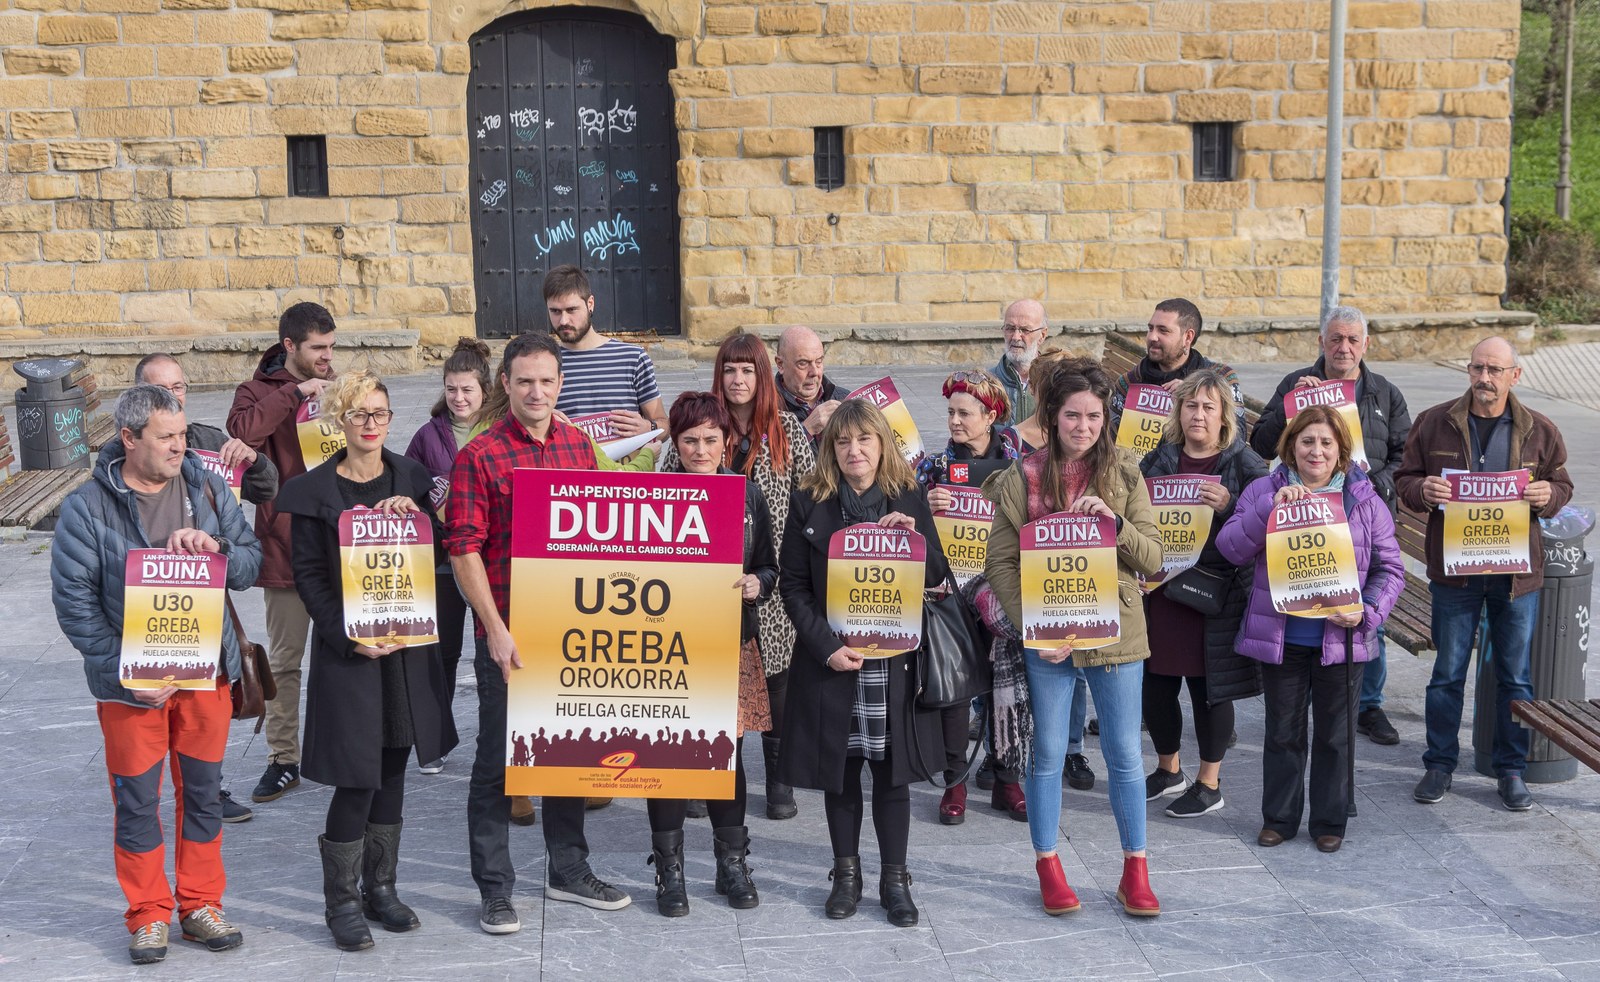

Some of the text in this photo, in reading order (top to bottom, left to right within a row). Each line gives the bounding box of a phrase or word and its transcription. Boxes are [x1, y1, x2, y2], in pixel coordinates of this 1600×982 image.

[1138, 392, 1174, 411] DUIN
[1295, 387, 1346, 411] DUINA
[550, 484, 709, 501] LAN-PENTSIO-BIZITZA
[1459, 481, 1518, 497] DUINA
[1034, 516, 1101, 526] LAN-PENTSIO-BIZITZA
[1160, 511, 1192, 526] U30
[1276, 503, 1335, 525] DUINA
[1468, 508, 1503, 521] U30
[352, 520, 419, 539] DUINA
[549, 501, 710, 544] DUINA
[1463, 524, 1510, 537] GREBA
[845, 528, 911, 536] LAN-PENTSIO-BIZITZA
[953, 525, 989, 542] U30
[1035, 523, 1102, 542] DUINA
[1159, 529, 1196, 543] REBA
[546, 542, 709, 556] SOBERANÍA PARA EL CAMBIO SOCIAL
[844, 535, 912, 553] DUINA
[1287, 532, 1326, 551] U30
[1462, 537, 1511, 546] OROKORRA
[947, 543, 985, 560] GREB
[1485, 548, 1511, 556] GENERAL
[1047, 556, 1089, 573] U30
[1287, 551, 1337, 570] GREBA
[142, 561, 211, 580] DUINA
[608, 572, 640, 582] URTARRILA
[854, 567, 895, 583] U30
[1288, 566, 1339, 580] OROKORRA
[362, 574, 413, 590] GREBA
[1043, 577, 1097, 593] GREBA
[1288, 579, 1342, 591] HUELGA GENERAL
[153, 594, 193, 612] U30
[574, 577, 671, 616] U30
[849, 588, 902, 604] GREBA
[1043, 593, 1098, 605] OROKORRA
[848, 604, 902, 615] OROKORRA
[1042, 608, 1100, 617] HUELGA GENERAL
[147, 617, 200, 633] GREBA
[645, 616, 665, 624] ENERO
[873, 620, 902, 628] GENERAL
[145, 634, 200, 644] OROKORRA
[562, 629, 689, 665] GREBA
[143, 649, 200, 657] HUELGA GENERAL
[559, 667, 689, 690] OROKORRA
[555, 703, 690, 719] HUELGA GENERAL
